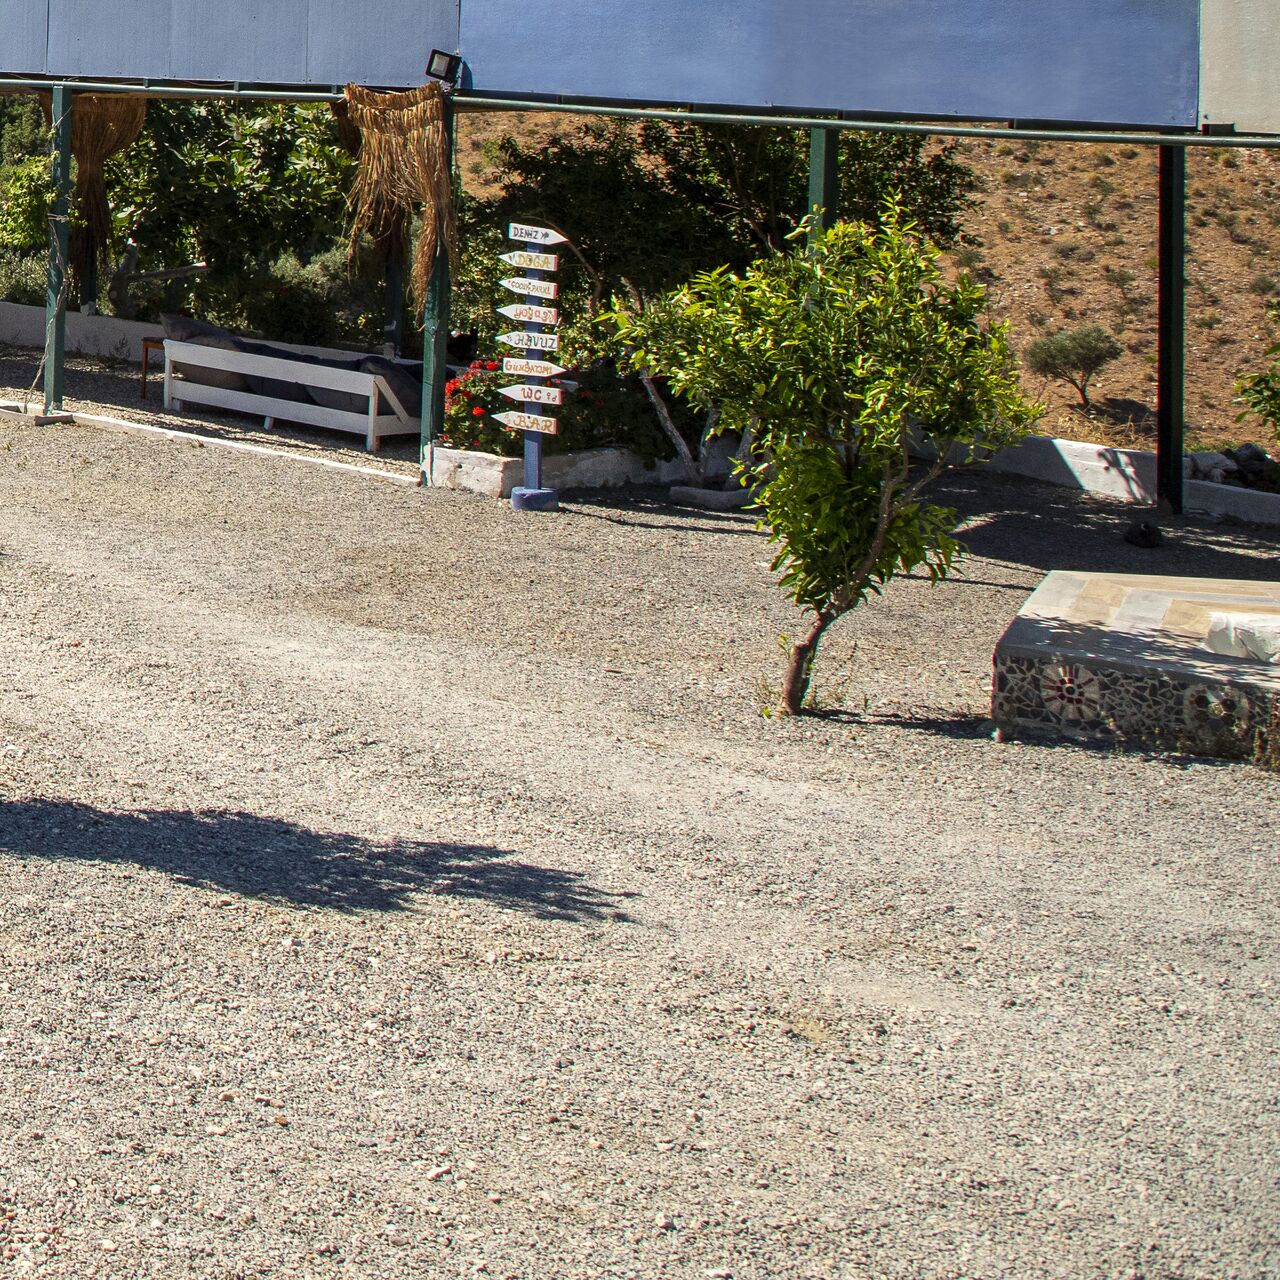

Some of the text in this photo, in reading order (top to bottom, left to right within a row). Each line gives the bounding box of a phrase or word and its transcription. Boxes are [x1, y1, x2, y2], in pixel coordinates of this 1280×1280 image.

[515, 334, 556, 349] HAVUZ
[521, 387, 541, 400] WC
[513, 416, 552, 432] BAR
